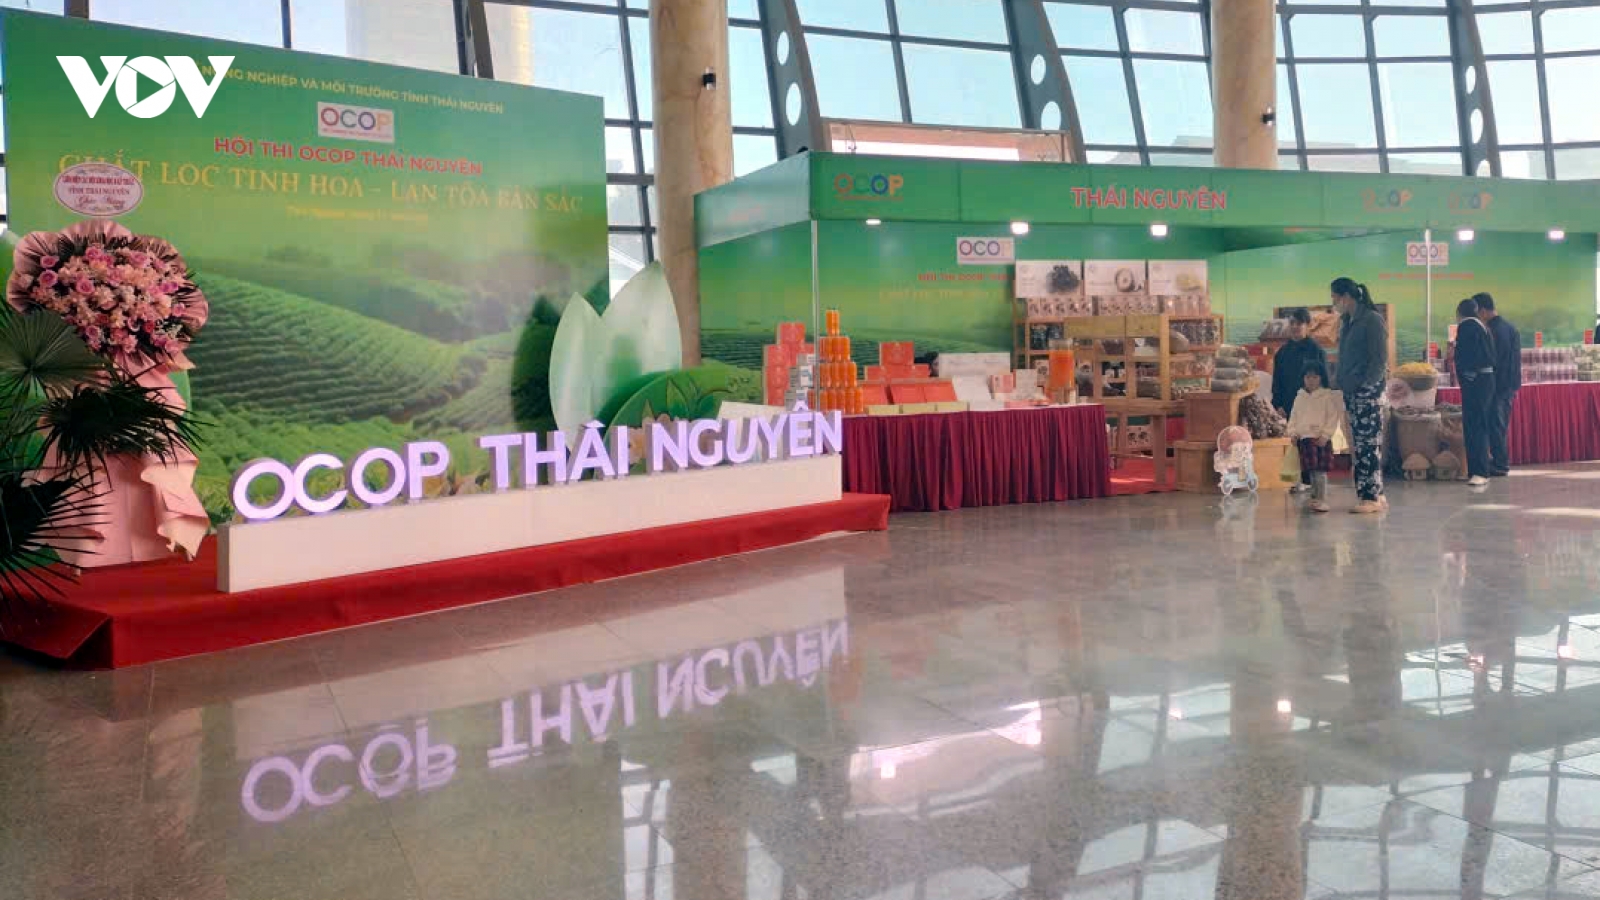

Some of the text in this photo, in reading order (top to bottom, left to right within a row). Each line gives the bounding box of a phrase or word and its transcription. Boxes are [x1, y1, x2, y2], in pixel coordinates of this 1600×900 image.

[321, 107, 393, 131] OCOP
[214, 135, 483, 175] HỘI THI OCOP THÁI NGUYÊN
[309, 173, 364, 198] HOA
[834, 173, 904, 195] OCOP
[1071, 184, 1227, 210] THÁI NGUYÊN
[231, 440, 449, 521] OCOP
[650, 399, 843, 473] NGUYÊN
